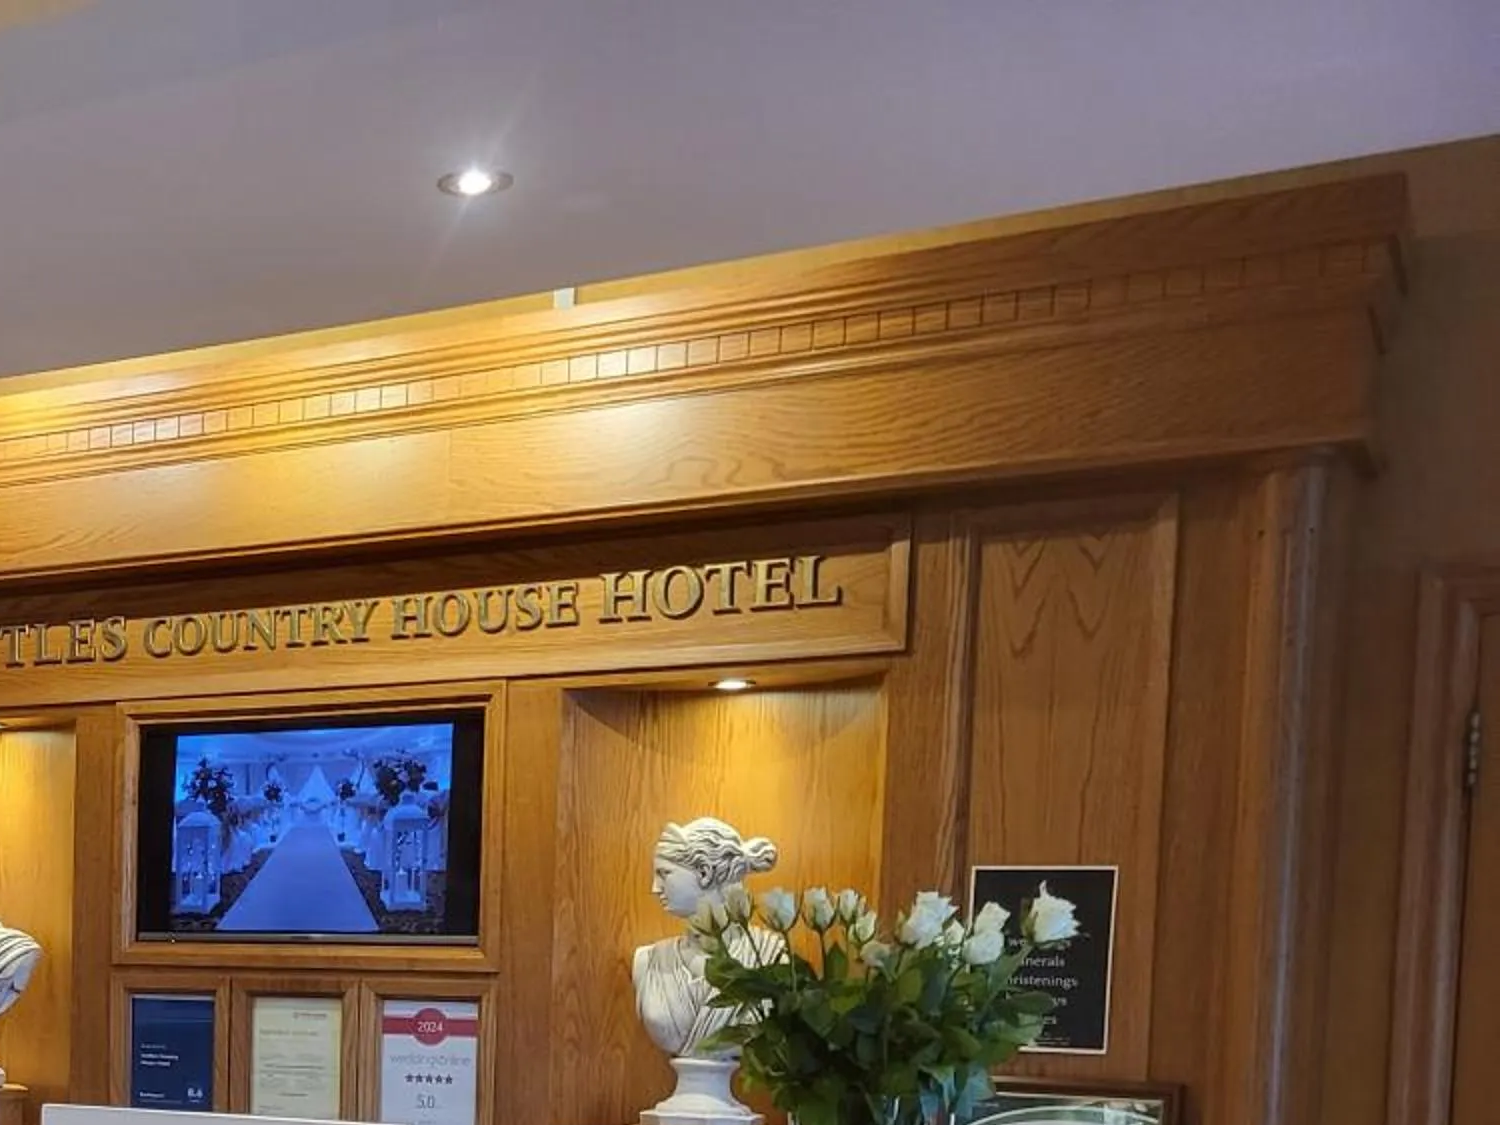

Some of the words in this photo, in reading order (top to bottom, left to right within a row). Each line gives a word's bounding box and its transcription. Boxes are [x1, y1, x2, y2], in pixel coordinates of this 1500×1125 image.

[143, 598, 380, 659] COUNTRY
[391, 581, 580, 642] HOUSE
[598, 554, 843, 624] HOTEL
[417, 1021, 443, 1033] 2024
